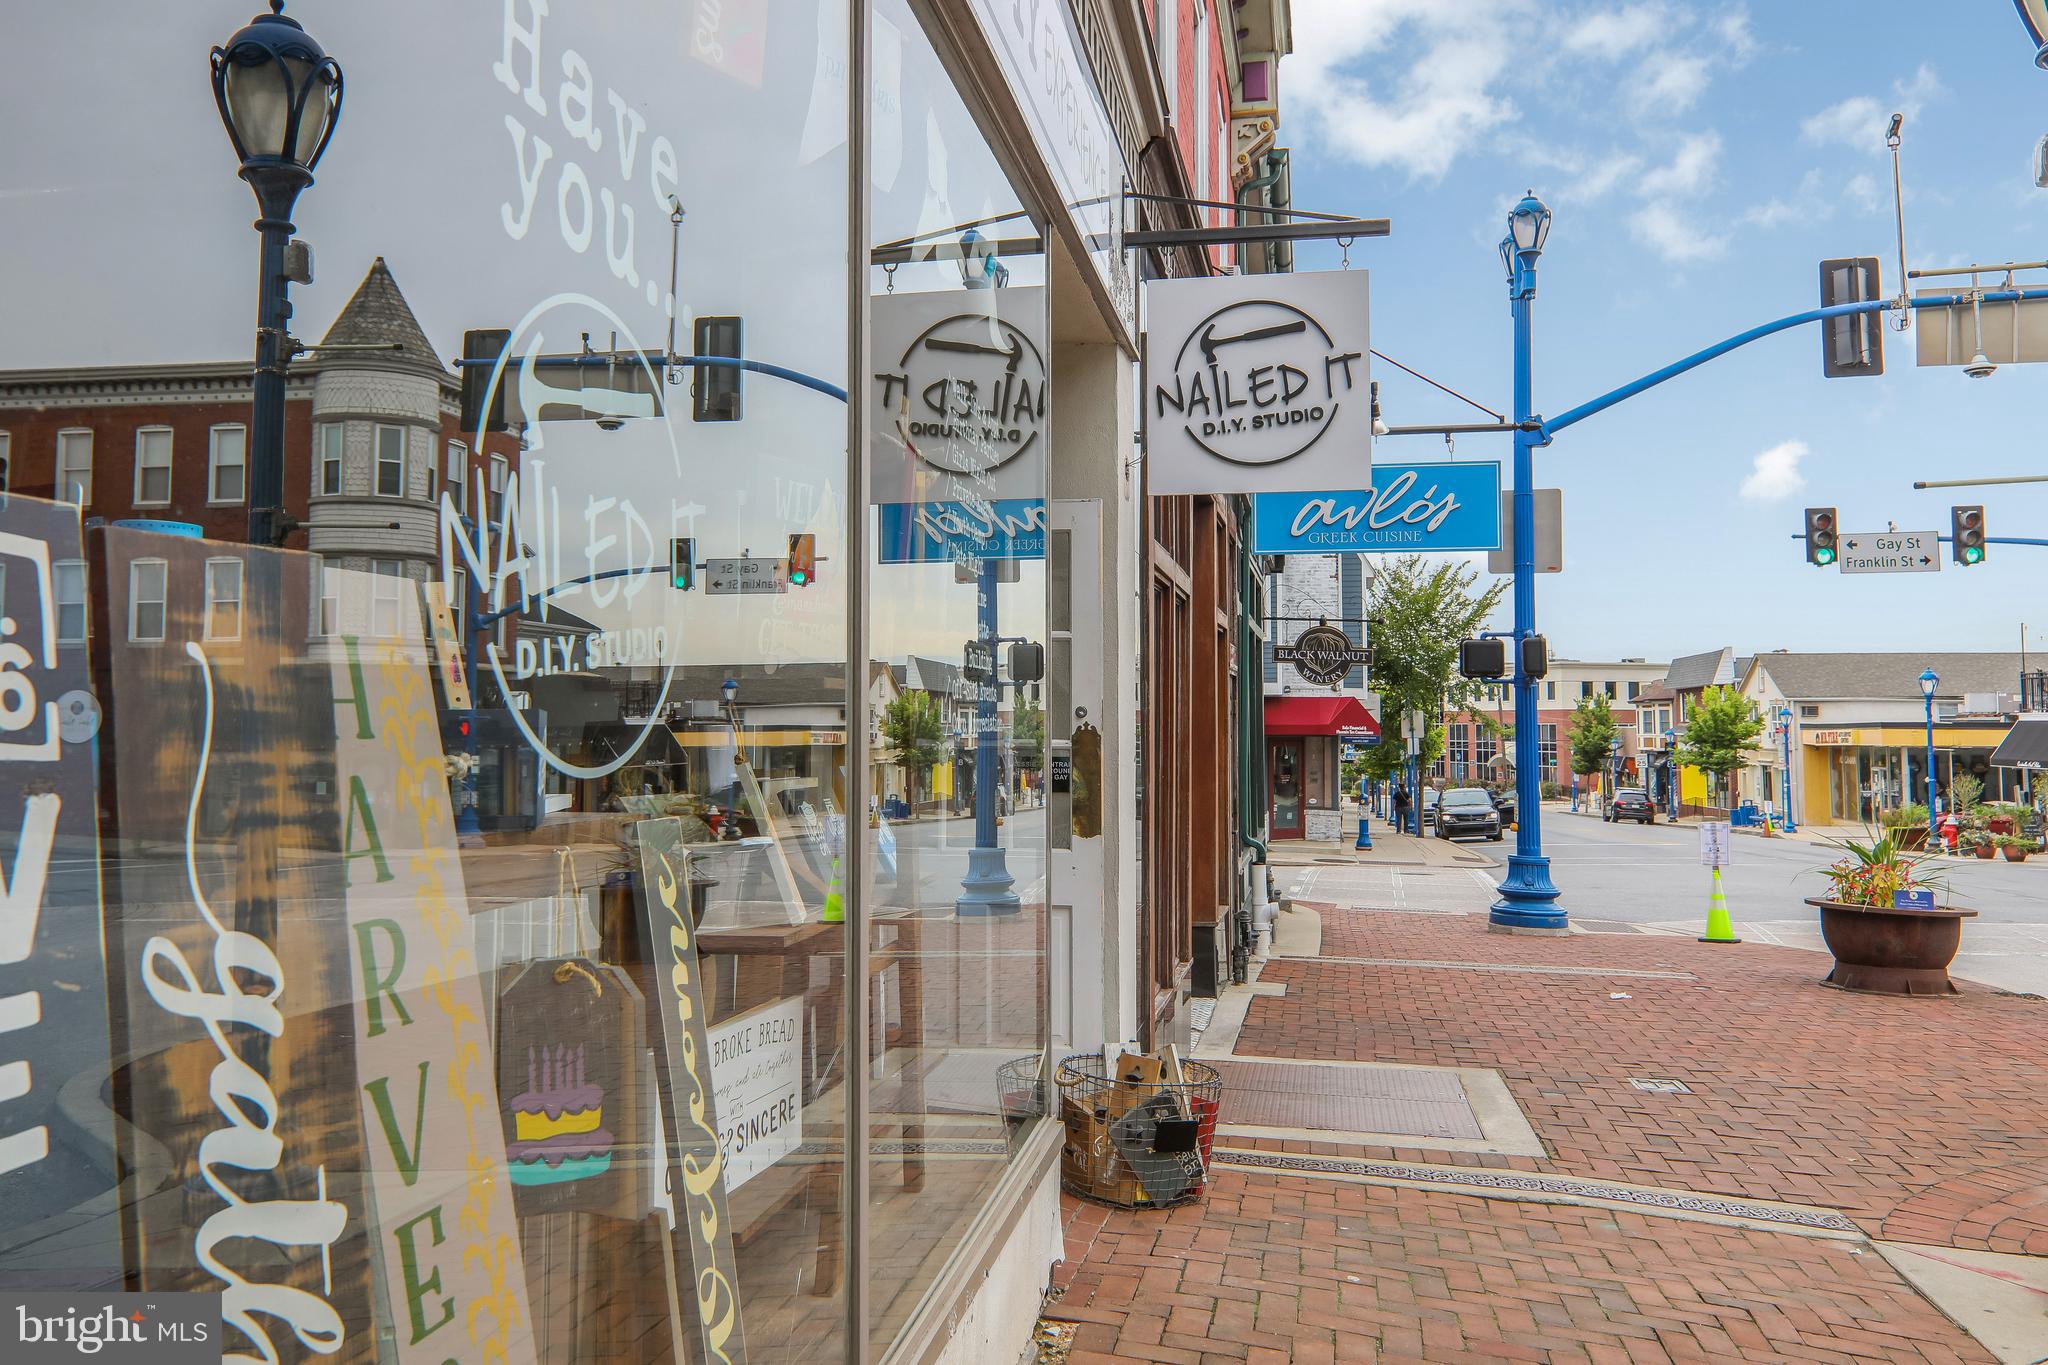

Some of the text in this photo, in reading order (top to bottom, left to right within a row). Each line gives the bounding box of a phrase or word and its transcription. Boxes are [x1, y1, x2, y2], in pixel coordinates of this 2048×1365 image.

[493, 0, 678, 214] Have
[1156, 353, 1362, 417] NAILED IT
[1203, 406, 1324, 436] D.I.Y. STUDIO
[440, 460, 655, 623] NAILED
[1308, 530, 1422, 545] GREEK CUISINE
[1876, 537, 1921, 552] Gay St
[1846, 555, 1914, 568] Franklin St
[516, 626, 668, 680] D.I.Y. STUDIO
[1278, 650, 1369, 661] BLACK WALNUT
[1302, 668, 1343, 683] WINERY
[714, 1018, 795, 1068] BROKE BREAD
[729, 1101, 745, 1118] WITH
[736, 1093, 796, 1154] SINCERE
